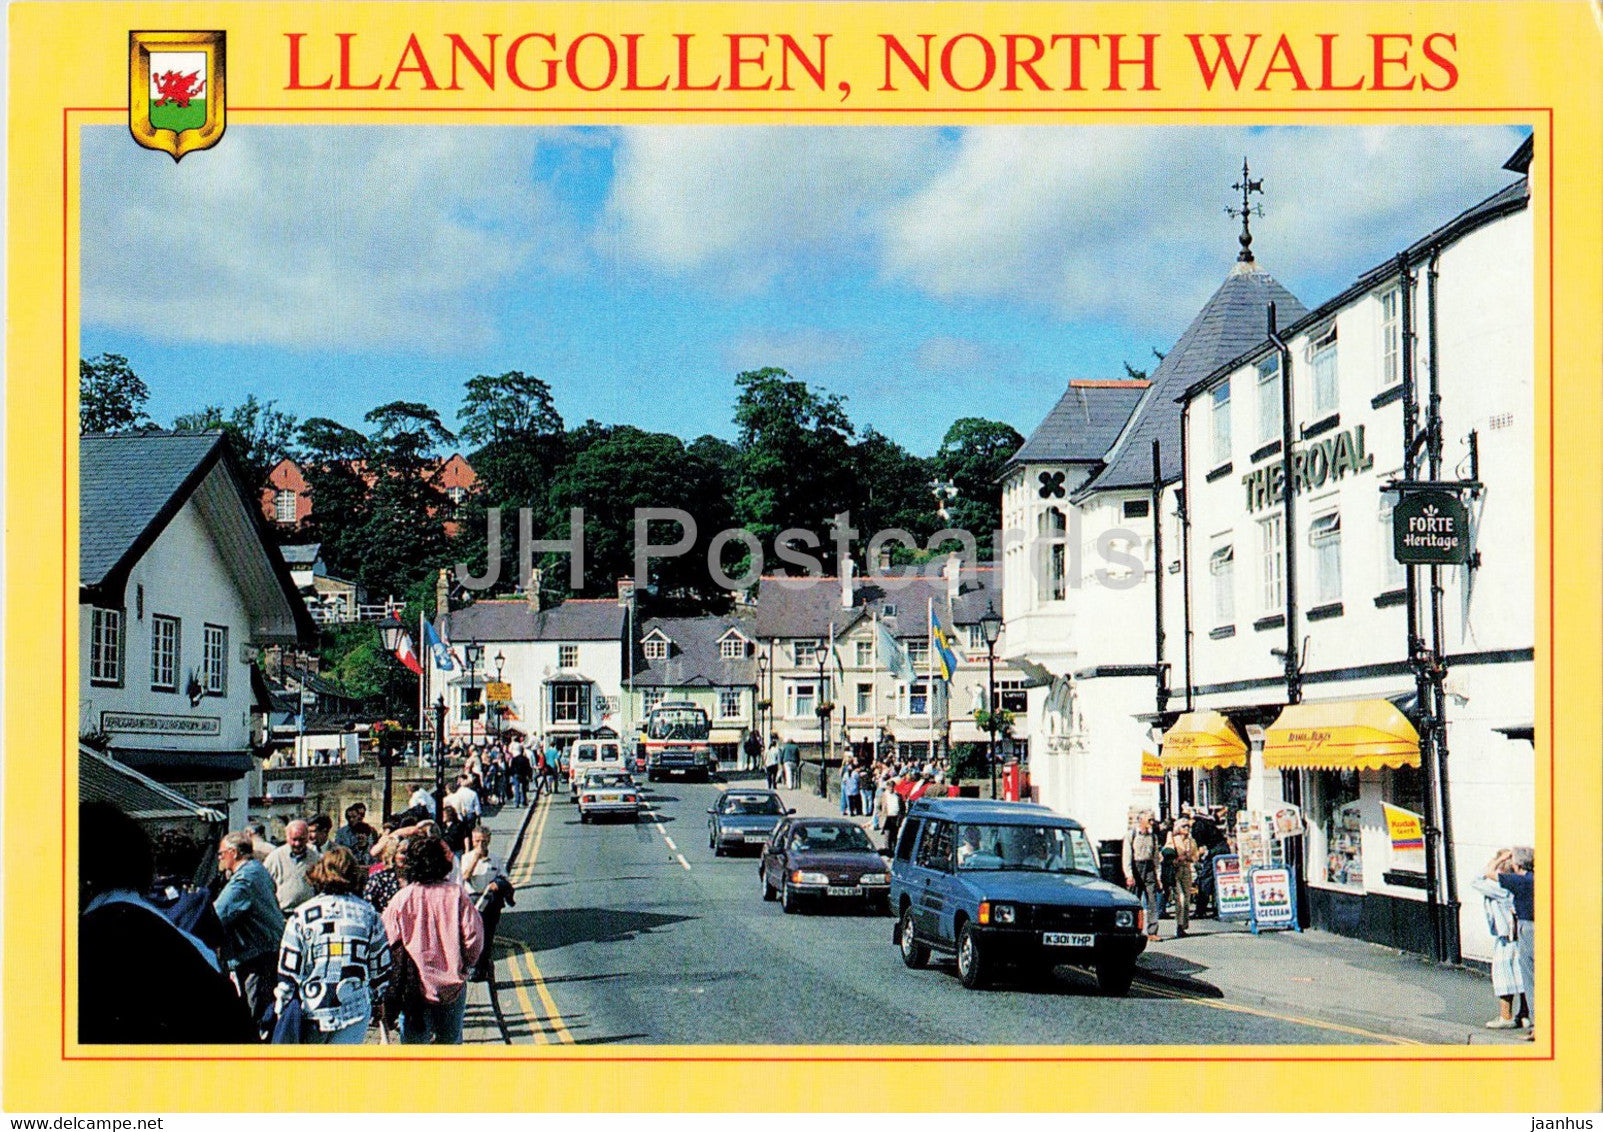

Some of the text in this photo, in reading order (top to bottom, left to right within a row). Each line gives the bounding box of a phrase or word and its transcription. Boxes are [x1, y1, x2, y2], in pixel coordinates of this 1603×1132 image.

[284, 32, 1458, 101] LLANGOLLEN, NORTH WALES
[1242, 424, 1374, 514] THE ROYAL
[1409, 516, 1454, 532] FORTE
[1403, 533, 1459, 551] Heritage
[1071, 935, 1092, 946] YHP
